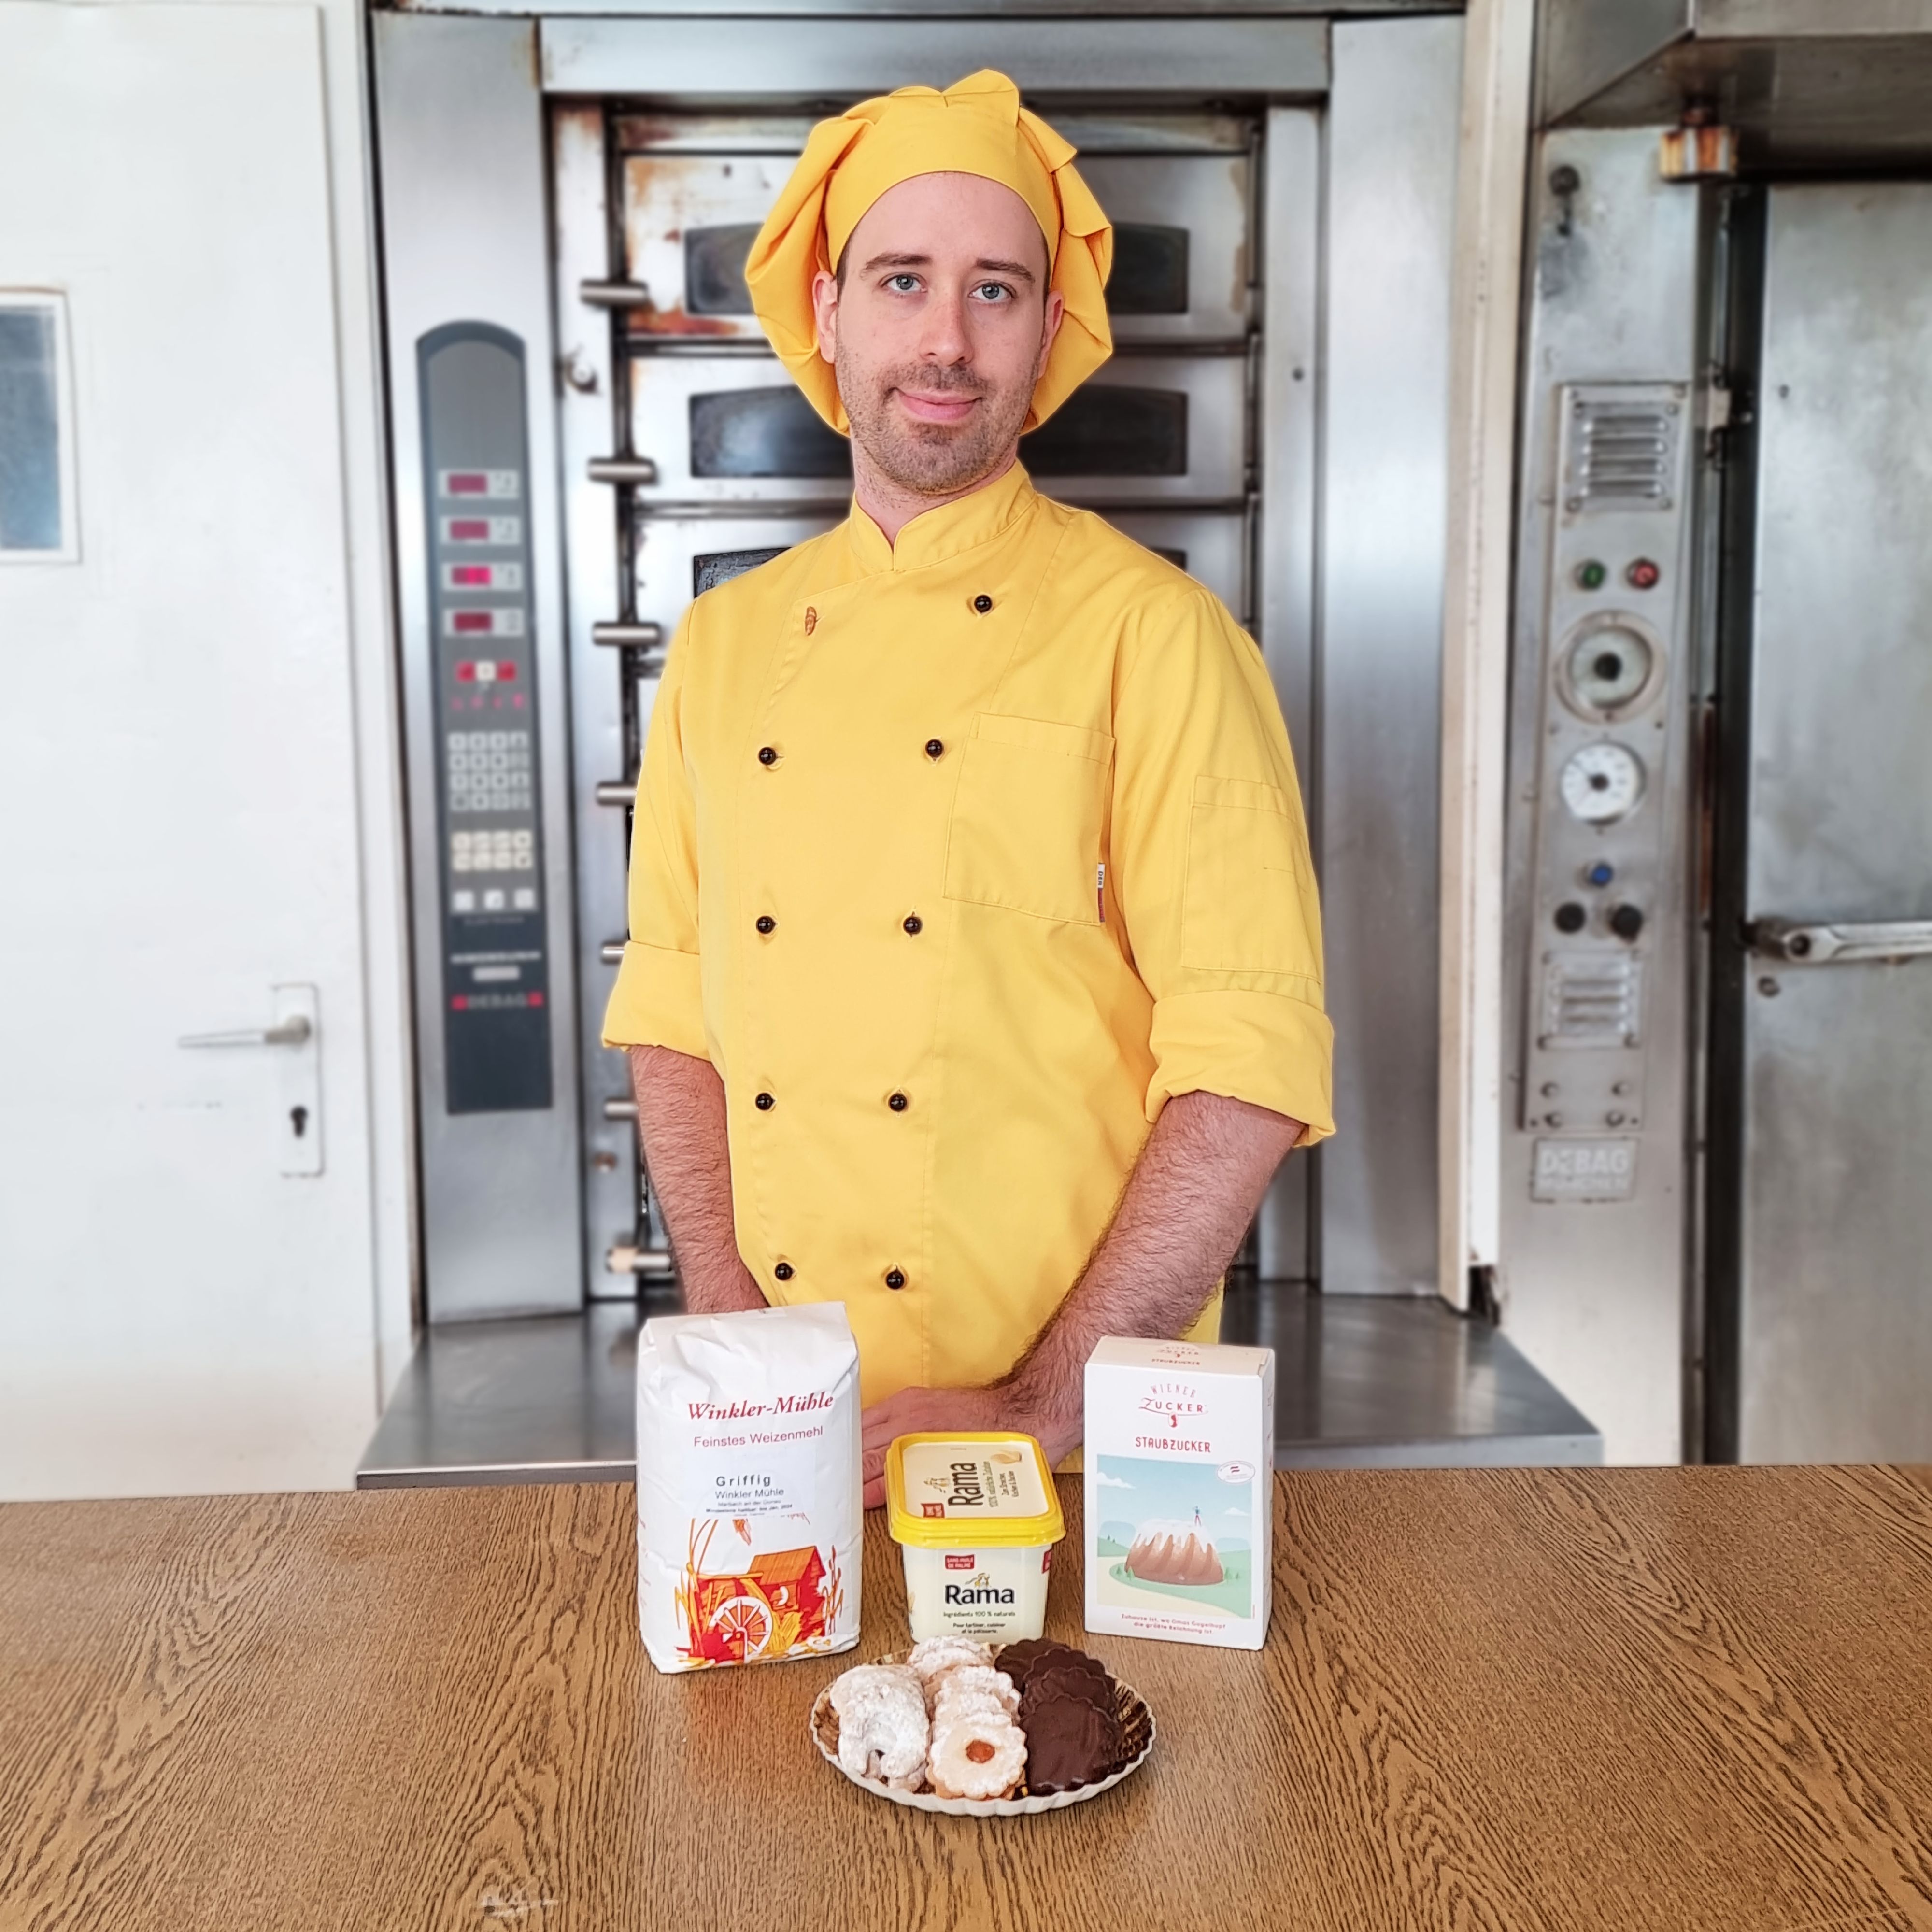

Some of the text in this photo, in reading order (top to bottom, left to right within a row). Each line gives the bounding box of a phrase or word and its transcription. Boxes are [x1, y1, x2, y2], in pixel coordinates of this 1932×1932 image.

[1151, 1383, 1196, 1398] WIENER
[688, 1391, 833, 1420] Winkler-Mühle
[1139, 1397, 1203, 1413] ZUCKER
[694, 1425, 823, 1447] Feinstes Weizenmehl
[1136, 1436, 1211, 1453] STAUBZUCKER
[716, 1475, 771, 1487] Griffig
[948, 1463, 984, 1506] Rama
[715, 1488, 784, 1499] Winkler Mühle
[945, 1584, 1014, 1605] Rama
[1192, 1620, 1226, 1630] Gugelhupf
